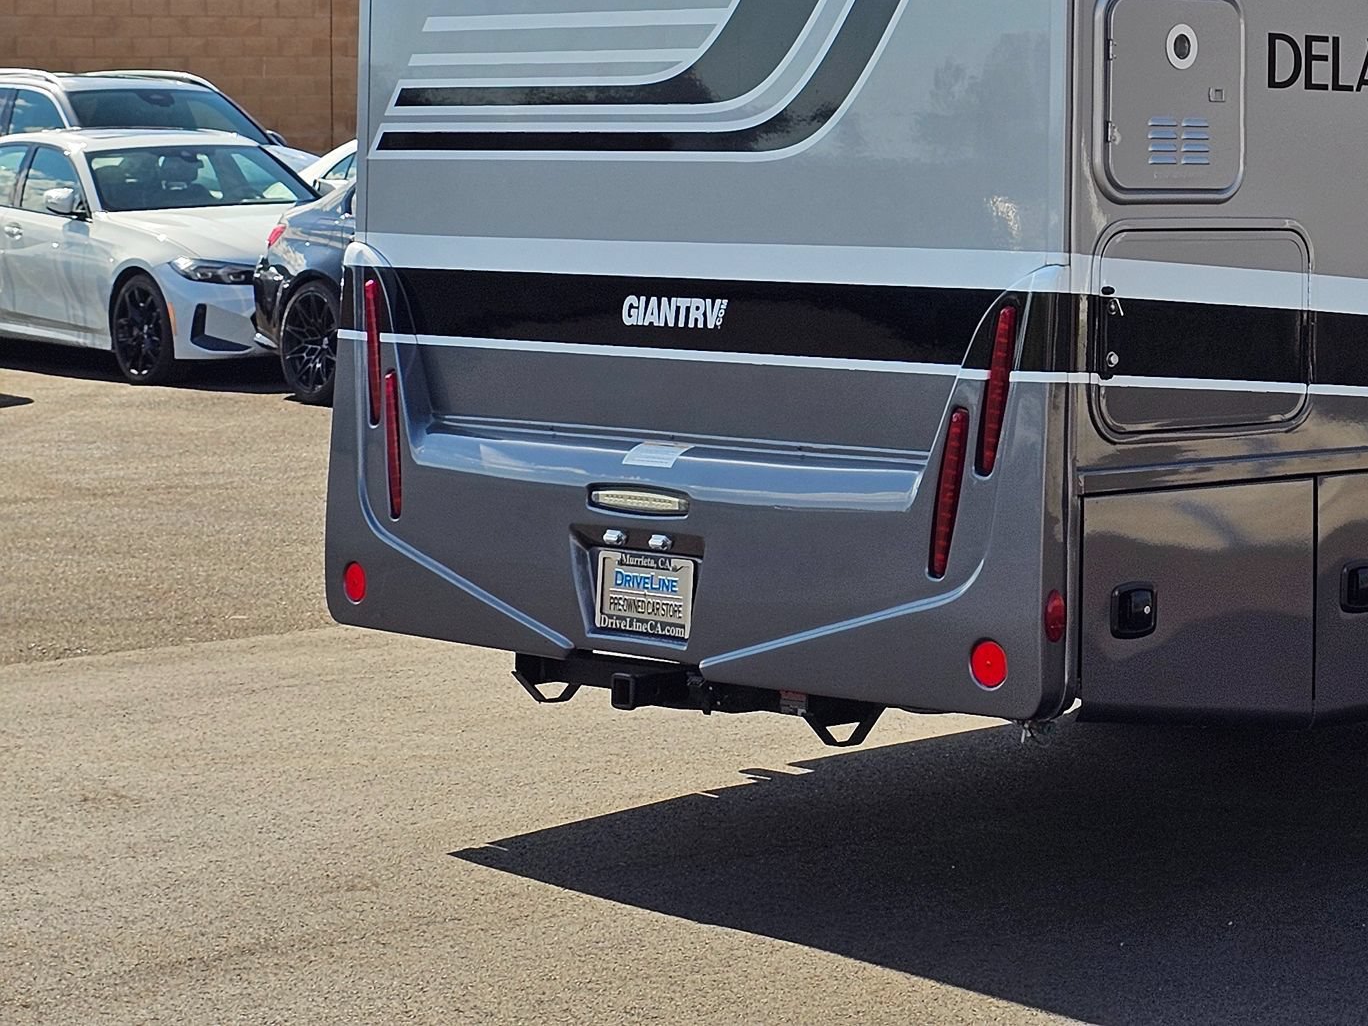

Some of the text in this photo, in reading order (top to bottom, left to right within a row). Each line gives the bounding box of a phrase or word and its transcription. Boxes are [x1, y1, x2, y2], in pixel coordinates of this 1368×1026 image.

[620, 553, 657, 569] Murrieta,
[646, 600, 661, 616] CAR
[661, 602, 683, 619] STORE
[600, 615, 684, 637] DriveLineCA.com
